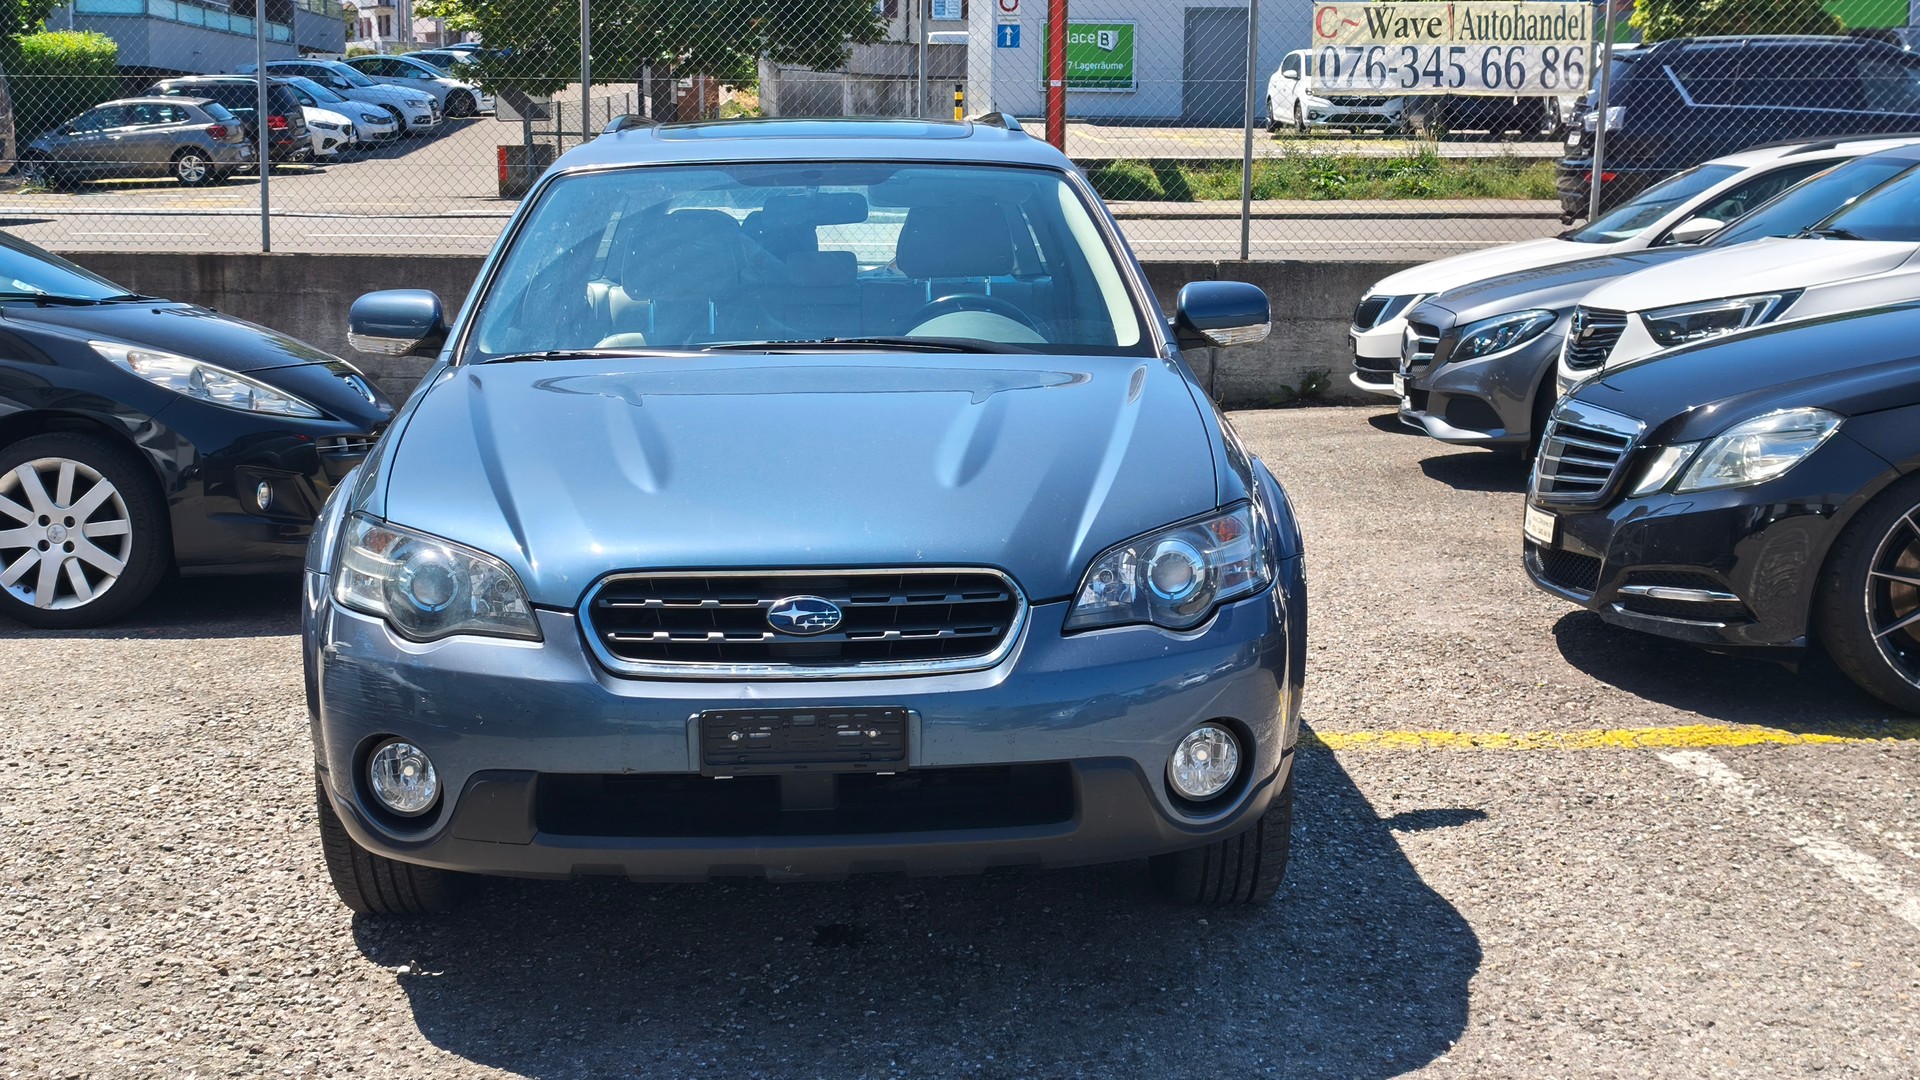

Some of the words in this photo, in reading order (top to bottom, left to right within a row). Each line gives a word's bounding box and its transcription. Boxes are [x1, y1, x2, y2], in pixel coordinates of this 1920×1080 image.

[1459, 4, 1587, 41] Autohandel
[1067, 30, 1096, 44] lace
[1075, 60, 1124, 71] Lagerräume
[1319, 45, 1466, 89] 076-345
[1481, 45, 1526, 90] 66
[1540, 45, 1584, 90] 86
